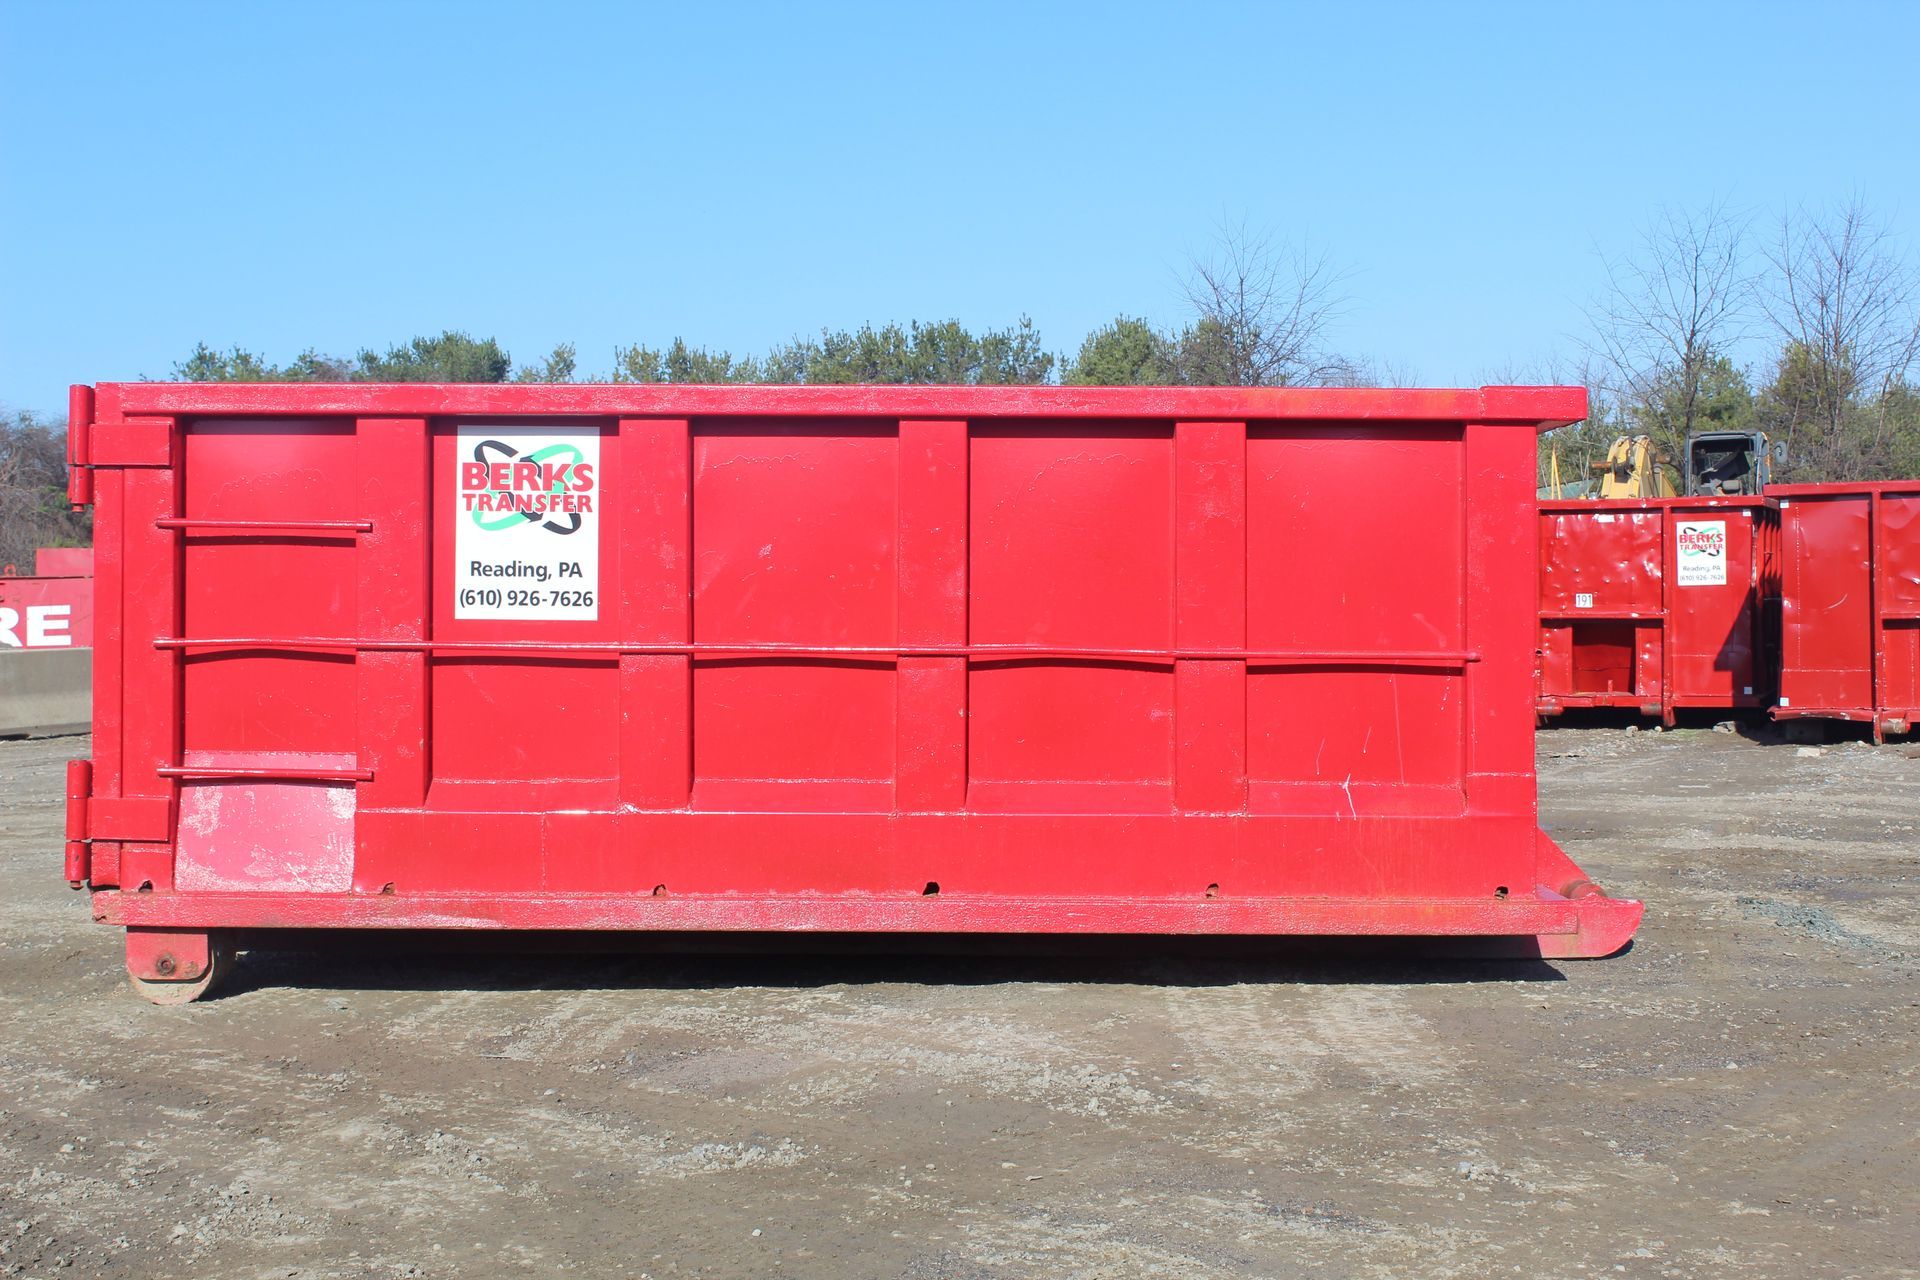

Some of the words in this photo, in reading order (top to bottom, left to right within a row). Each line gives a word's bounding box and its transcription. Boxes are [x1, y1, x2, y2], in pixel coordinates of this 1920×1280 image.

[462, 462, 594, 492] BERKS
[462, 493, 593, 513] TRANSFER
[1679, 533, 1724, 544] BERKS
[470, 561, 552, 582] Reading,
[559, 562, 583, 578] PA
[460, 588, 502, 608] (610)
[507, 590, 594, 607] 926-7626
[1577, 594, 1592, 607] 191
